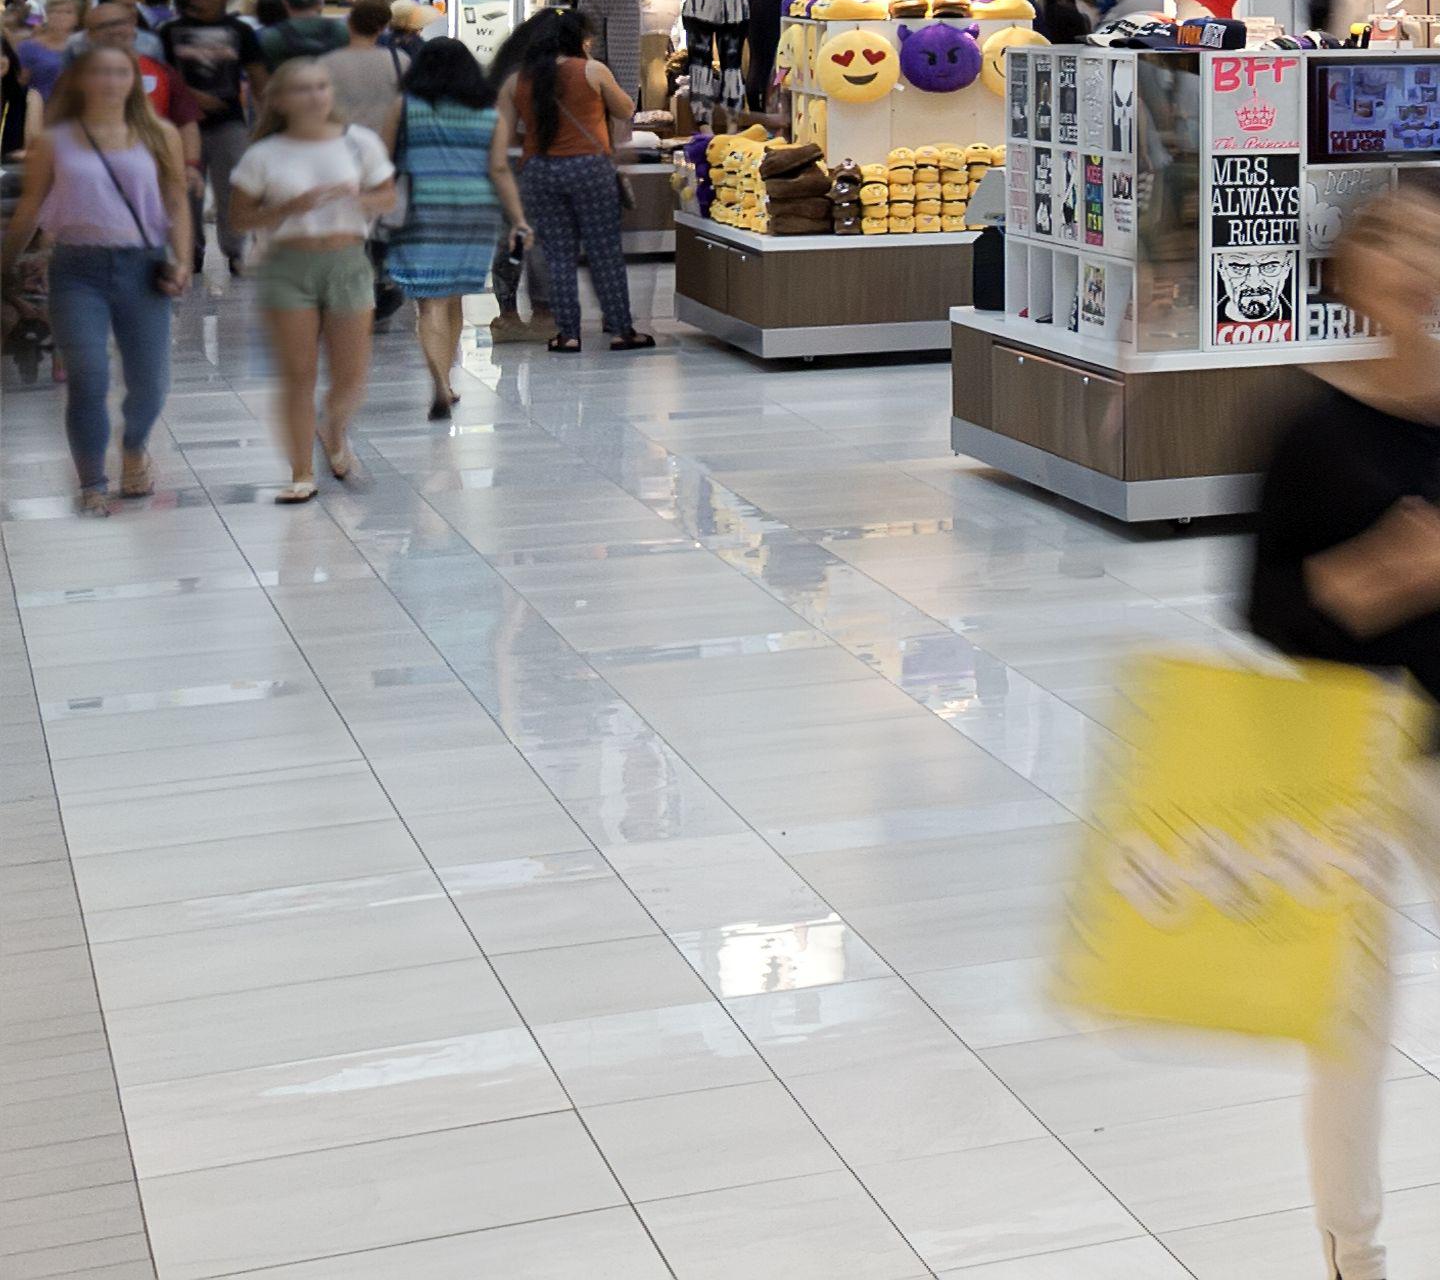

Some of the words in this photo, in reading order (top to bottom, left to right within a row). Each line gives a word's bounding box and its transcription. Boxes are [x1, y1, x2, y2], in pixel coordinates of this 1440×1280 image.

[1331, 139, 1386, 153] MUGS
[1213, 156, 1275, 186] MRS.
[1212, 186, 1300, 217] ALWAYS
[1228, 218, 1299, 246] RIGHT
[1217, 322, 1291, 345] COOK
